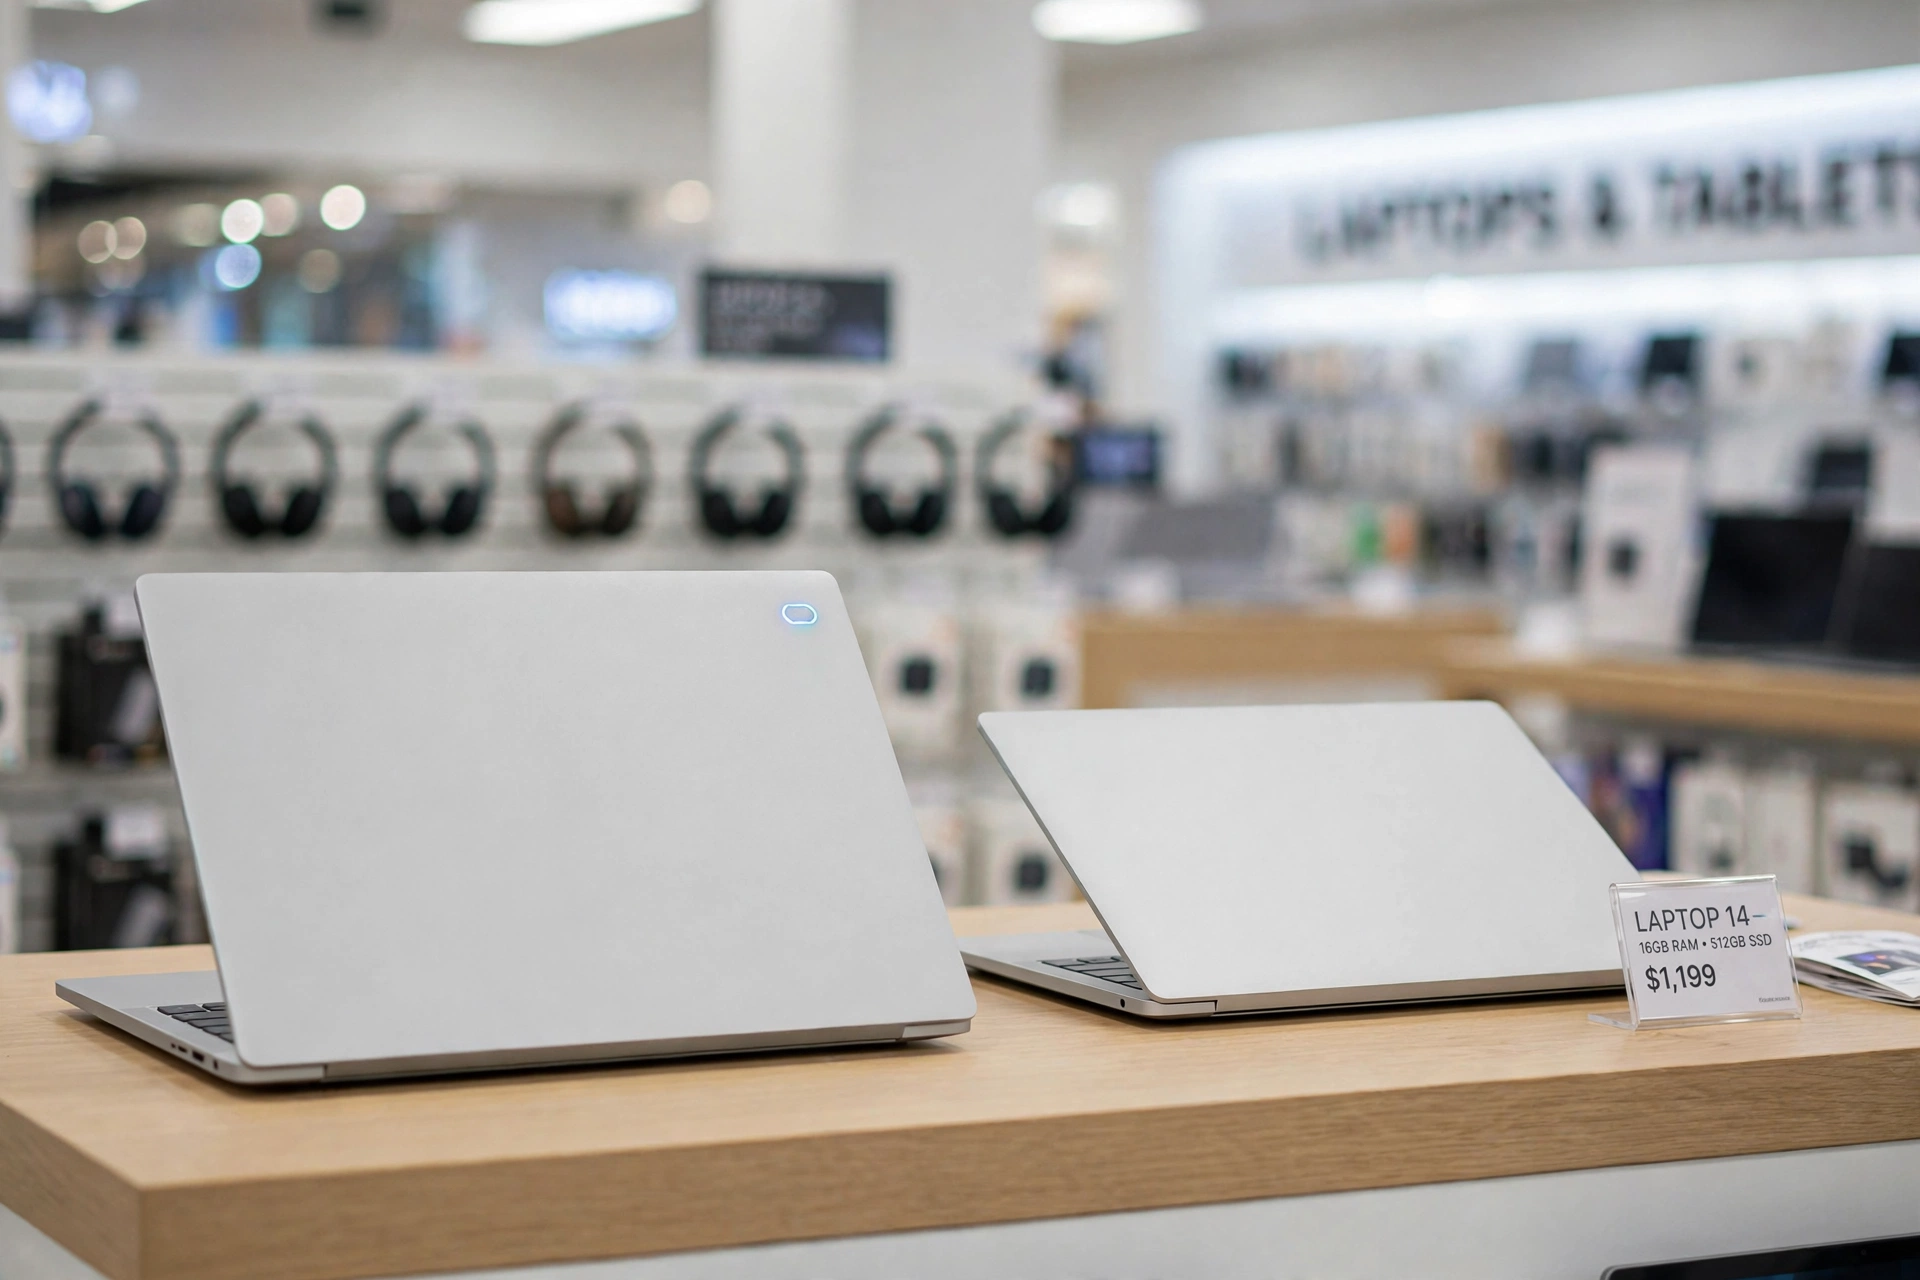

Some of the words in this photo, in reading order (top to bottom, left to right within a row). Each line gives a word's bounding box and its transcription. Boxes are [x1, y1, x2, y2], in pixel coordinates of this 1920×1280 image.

[1634, 906, 1720, 933] LAPTOP
[1639, 940, 1670, 954] 16GB
[1671, 938, 1699, 952] RAM
[1710, 935, 1747, 950] 512GB
[1749, 933, 1772, 947] SSD
[1645, 963, 1717, 994] $1,199
